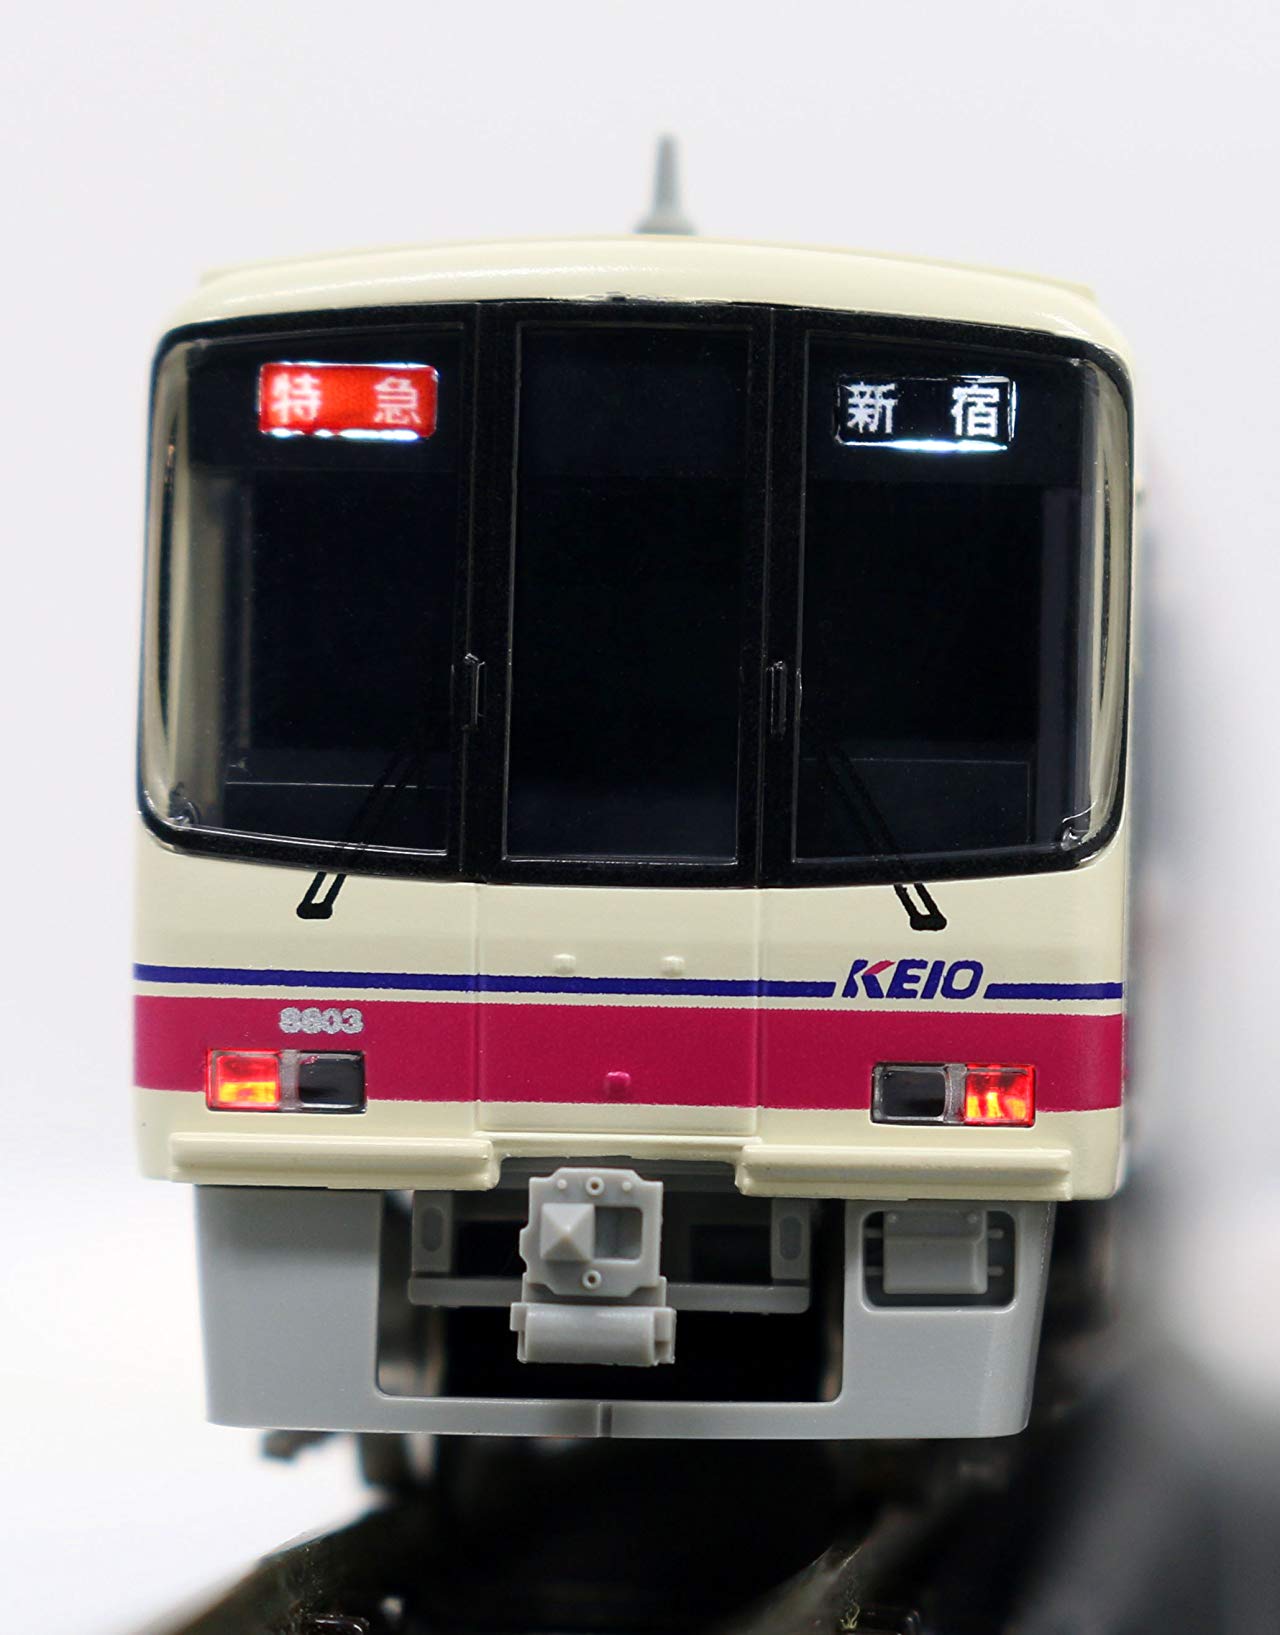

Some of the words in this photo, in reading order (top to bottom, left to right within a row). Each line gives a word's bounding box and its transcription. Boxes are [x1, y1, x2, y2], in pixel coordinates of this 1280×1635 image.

[271, 373, 420, 425] 特急
[847, 381, 1000, 437] 新宿
[842, 958, 984, 1000] KEIO
